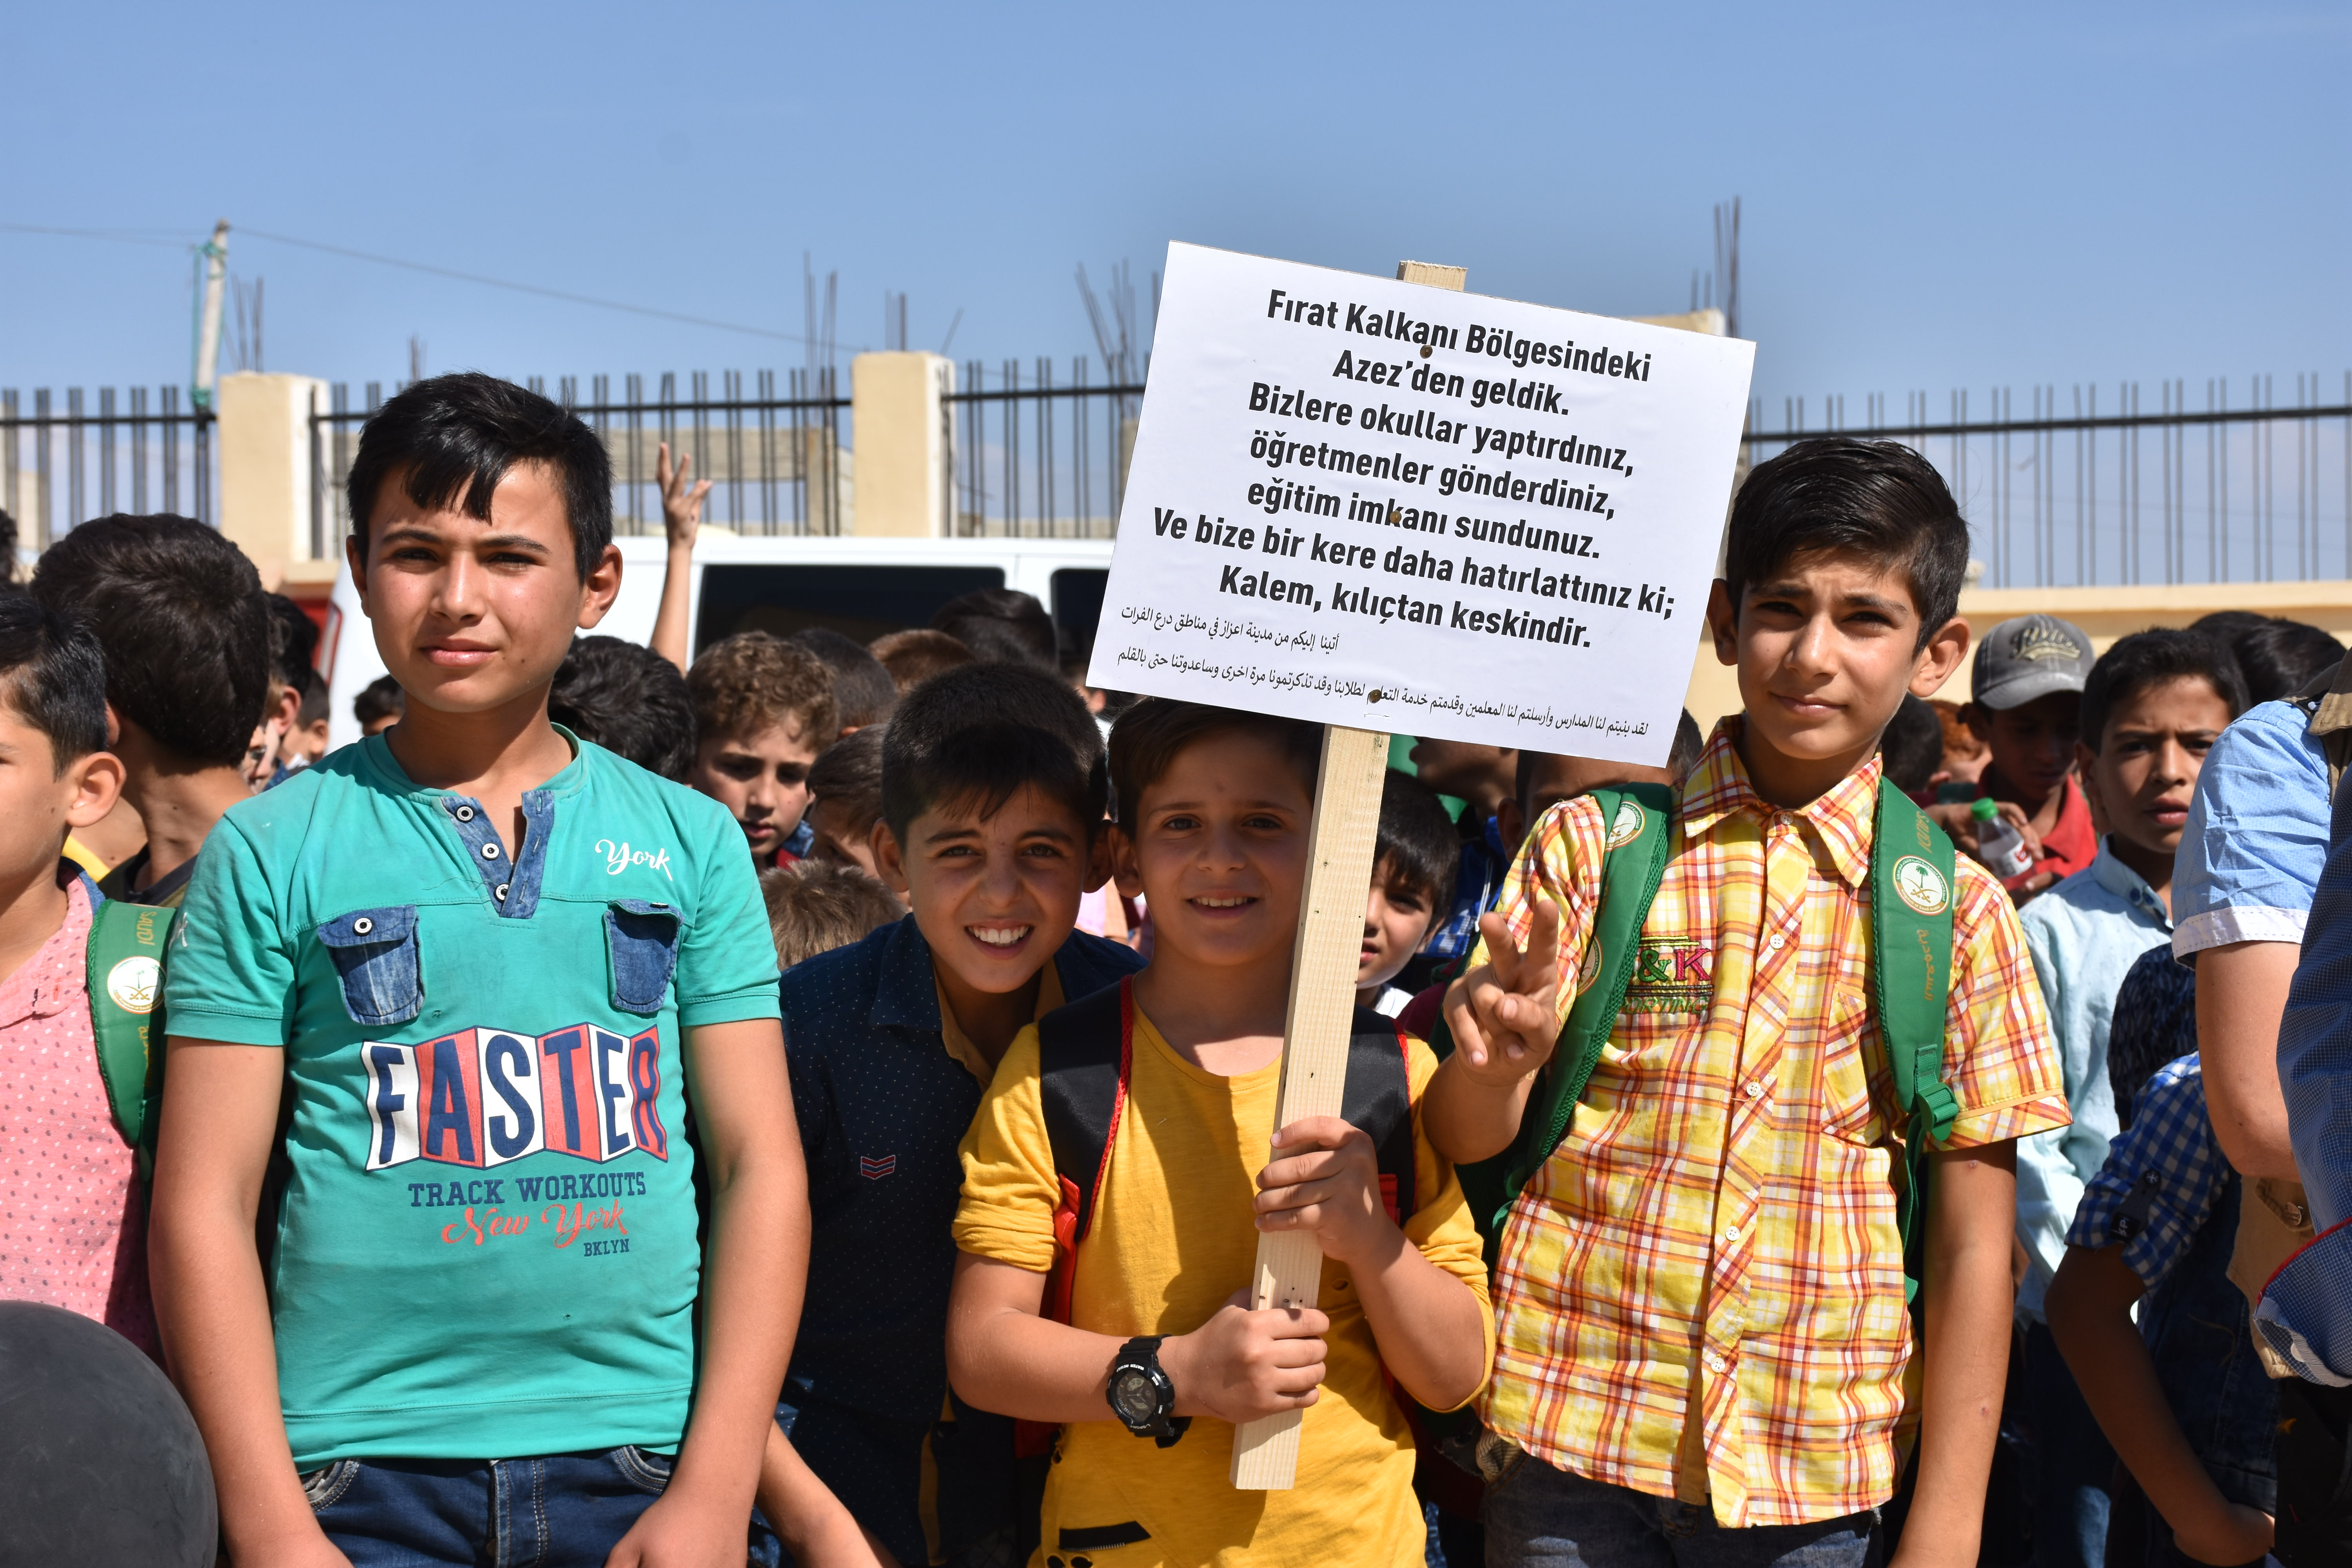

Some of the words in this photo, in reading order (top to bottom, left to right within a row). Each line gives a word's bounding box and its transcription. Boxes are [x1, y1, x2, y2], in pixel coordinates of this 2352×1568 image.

[1267, 289, 1339, 329] Fırat
[1345, 302, 1459, 351] Kalkanı
[1465, 323, 1651, 382] Bölgesindeki
[1470, 378, 1569, 416] geldik.
[1248, 381, 1353, 426] Bizlere
[1360, 403, 1468, 445] okullar
[1471, 425, 1633, 478] yaptırdınız,
[1250, 429, 1434, 485] öğretmenler
[1438, 463, 1615, 521] gönderdiniz,
[1247, 476, 1341, 518] eğitim
[1347, 492, 1448, 535] imkanı
[1454, 516, 1600, 559] sundunuz.
[1154, 506, 1188, 539] Ve
[1194, 514, 1255, 550] bize
[1261, 524, 1305, 558] bir
[1310, 532, 1376, 569] kere
[1383, 545, 1454, 582] daha
[1460, 556, 1632, 609] hatırlattınız
[1637, 583, 1675, 621] ki;
[1121, 607, 1154, 625] الفرات
[1219, 564, 1322, 613] Kalem,
[1331, 582, 1443, 626] kılıçtan
[1450, 600, 1591, 648] keskindir.
[1153, 612, 1173, 631] درع
[1174, 613, 1207, 632] مناطق
[1208, 617, 1219, 640] في
[1219, 620, 1244, 639] اعزاز
[1245, 621, 1273, 643] مدينة
[1274, 632, 1289, 647] من
[1117, 646, 1147, 667] بالقلم
[1148, 653, 1169, 670] حتى
[1221, 666, 1249, 682] اخرى
[1250, 666, 1266, 686] مرة
[1269, 669, 1314, 691] تذكرتمونا
[1314, 675, 1332, 696] وقد
[1334, 679, 1366, 699] لطلابنا
[1401, 688, 1428, 705] خدمة
[1429, 695, 1464, 715] وقدمتم
[1465, 701, 1506, 718] المعلمين
[1507, 704, 1518, 718] لنا
[1517, 706, 1553, 728] وأرسلتم
[1555, 713, 1594, 730] المدارس
[1595, 716, 1606, 730] لنا
[1606, 720, 1630, 738] بنيتم
[1631, 722, 1649, 735] لقد
[1916, 811, 1933, 853] SAUDI
[136, 911, 157, 946] SAUDI
[1916, 929, 1935, 1002] السعودية
[1622, 996, 1709, 1014] ORTING
[370, 1029, 666, 1165] FASTER
[408, 1179, 505, 1207] TRACK
[515, 1171, 647, 1203] WORKOUTS
[441, 1207, 530, 1246] New
[541, 1199, 628, 1249] York
[583, 1238, 630, 1257] BKLYN
